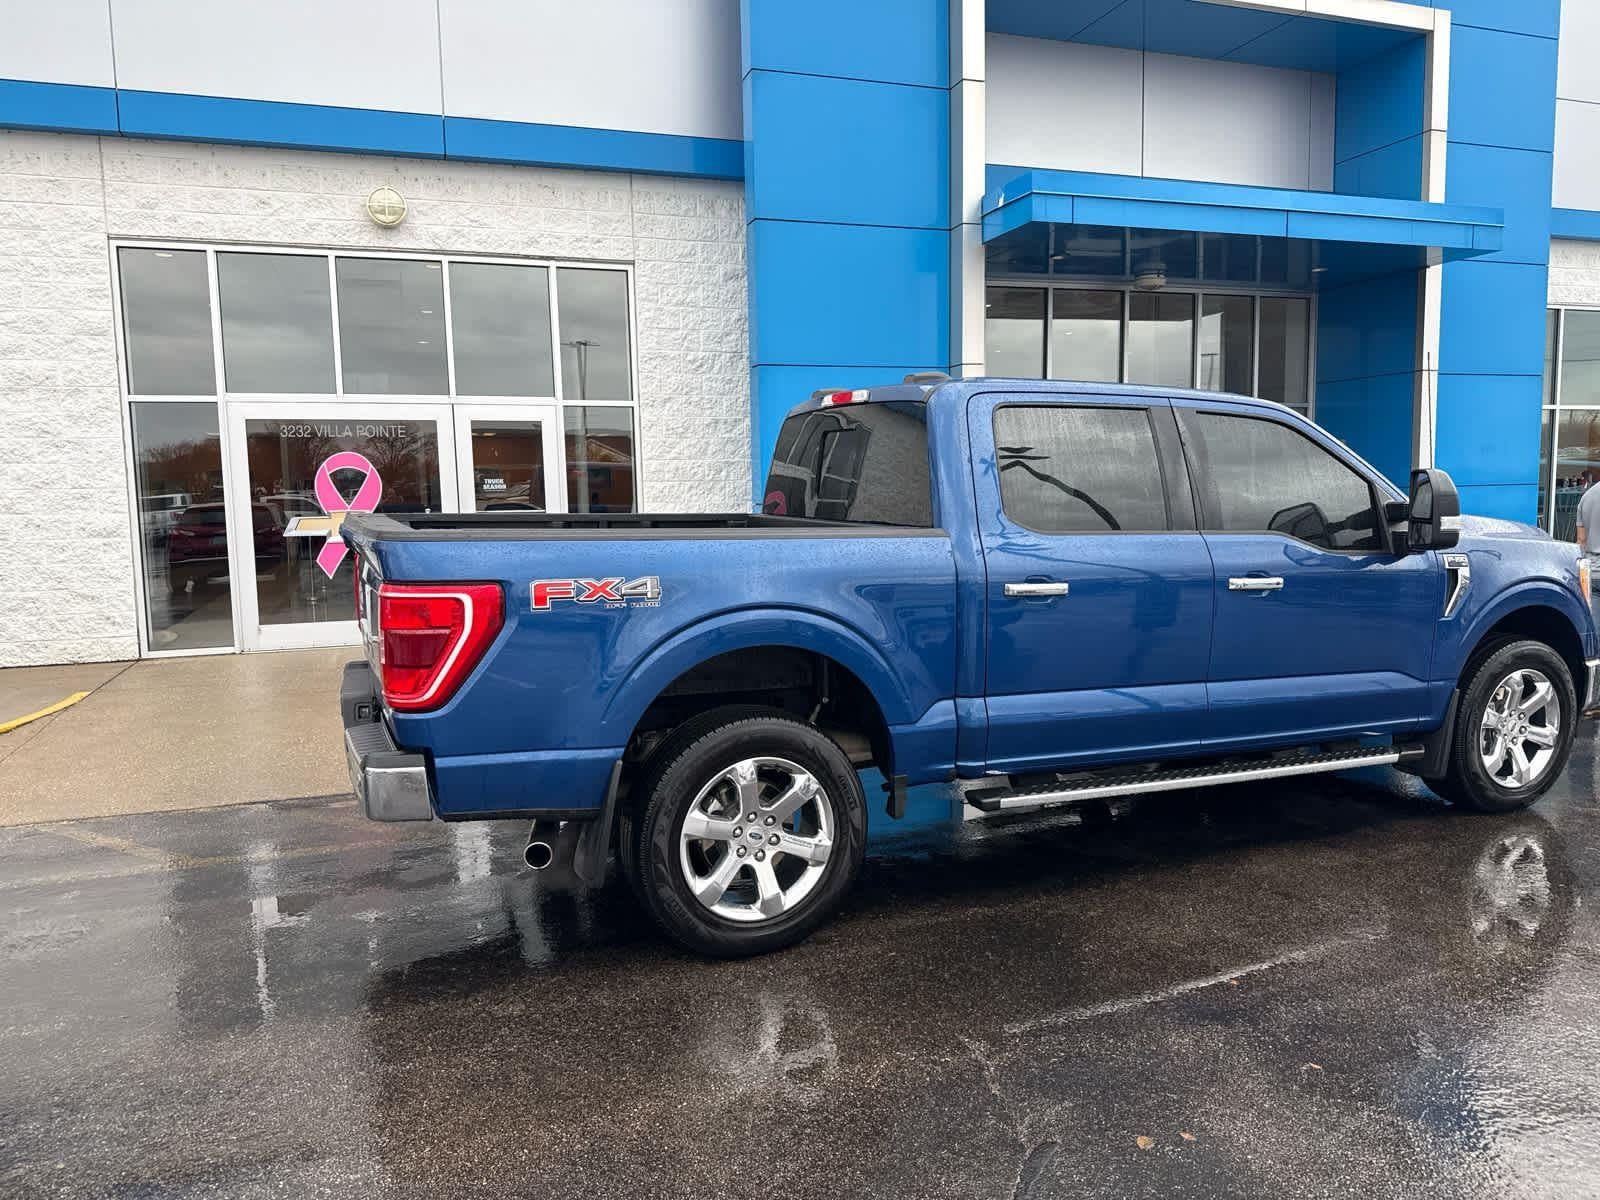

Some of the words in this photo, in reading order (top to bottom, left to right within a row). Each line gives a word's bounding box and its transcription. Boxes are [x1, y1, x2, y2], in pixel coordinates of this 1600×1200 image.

[280, 424, 312, 438] 3232
[314, 424, 352, 438] VILLA
[356, 424, 407, 438] POINTE
[530, 576, 662, 611] FX4
